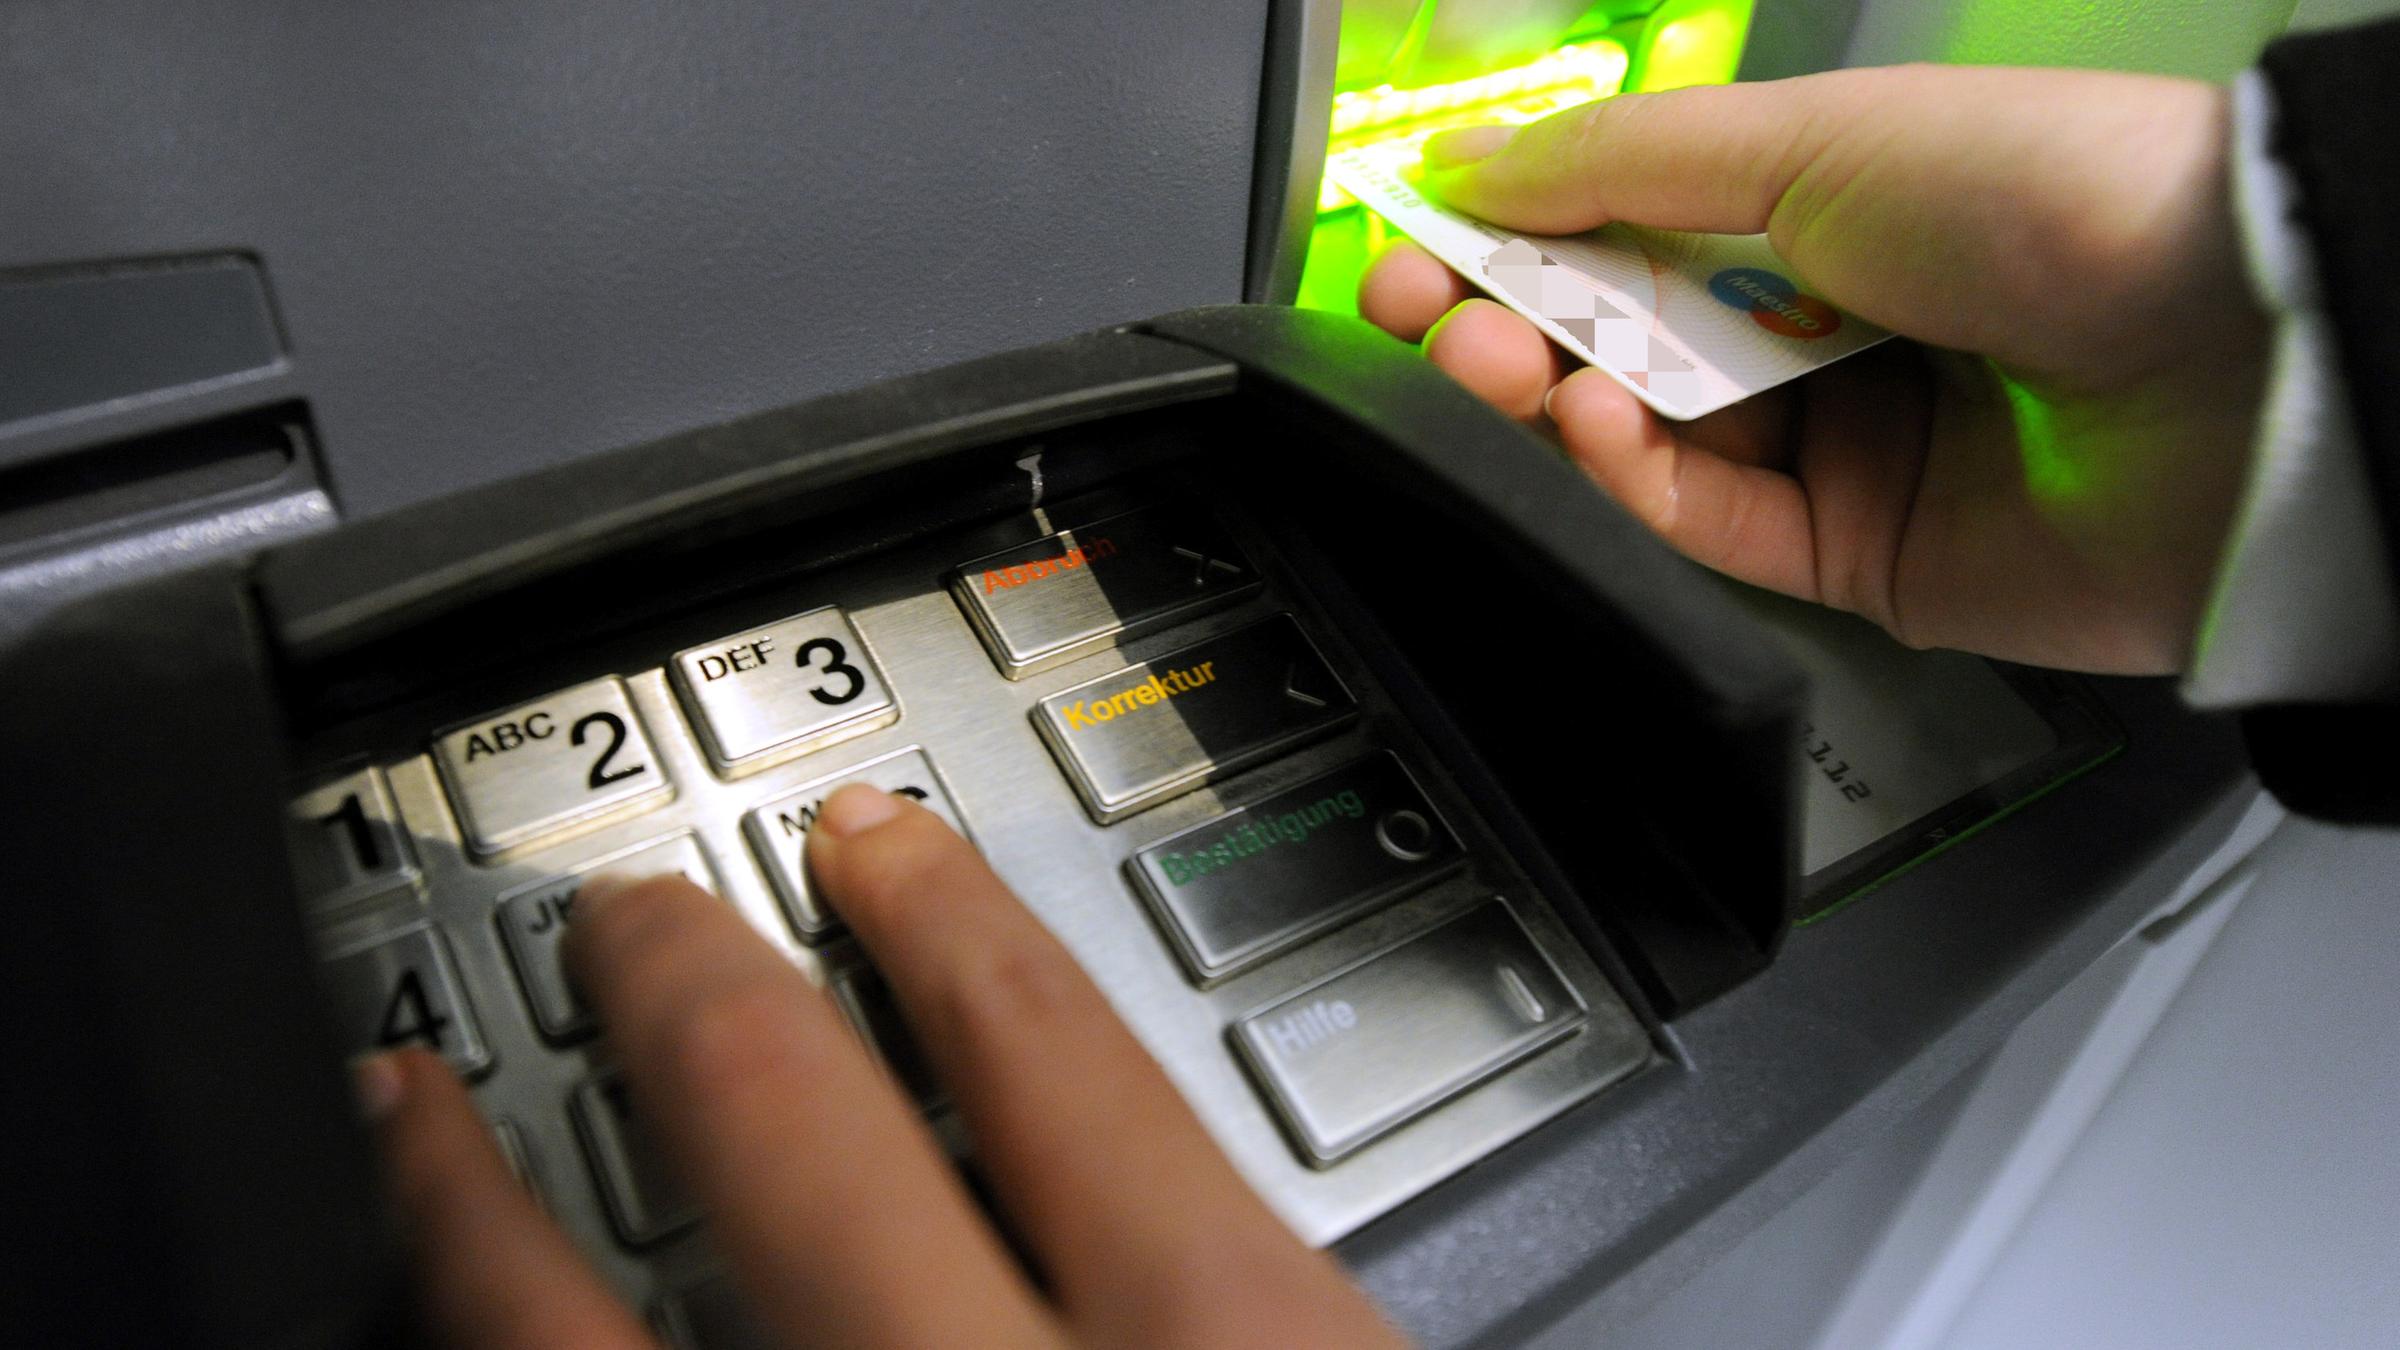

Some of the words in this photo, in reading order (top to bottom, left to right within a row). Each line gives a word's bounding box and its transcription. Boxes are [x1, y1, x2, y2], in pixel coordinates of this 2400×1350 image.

[1725, 276, 1820, 330] Maestro
[983, 537, 1116, 595] Abbruch
[698, 635, 776, 682] DEF
[795, 636, 866, 705] 3
[1061, 659, 1215, 731] Korrektur
[466, 711, 555, 762] ABC
[570, 711, 645, 789] 2
[321, 793, 383, 869] 1
[1160, 788, 1365, 887] Bestätigung
[382, 970, 446, 1047] 4
[1266, 999, 1358, 1057] Hilfe
